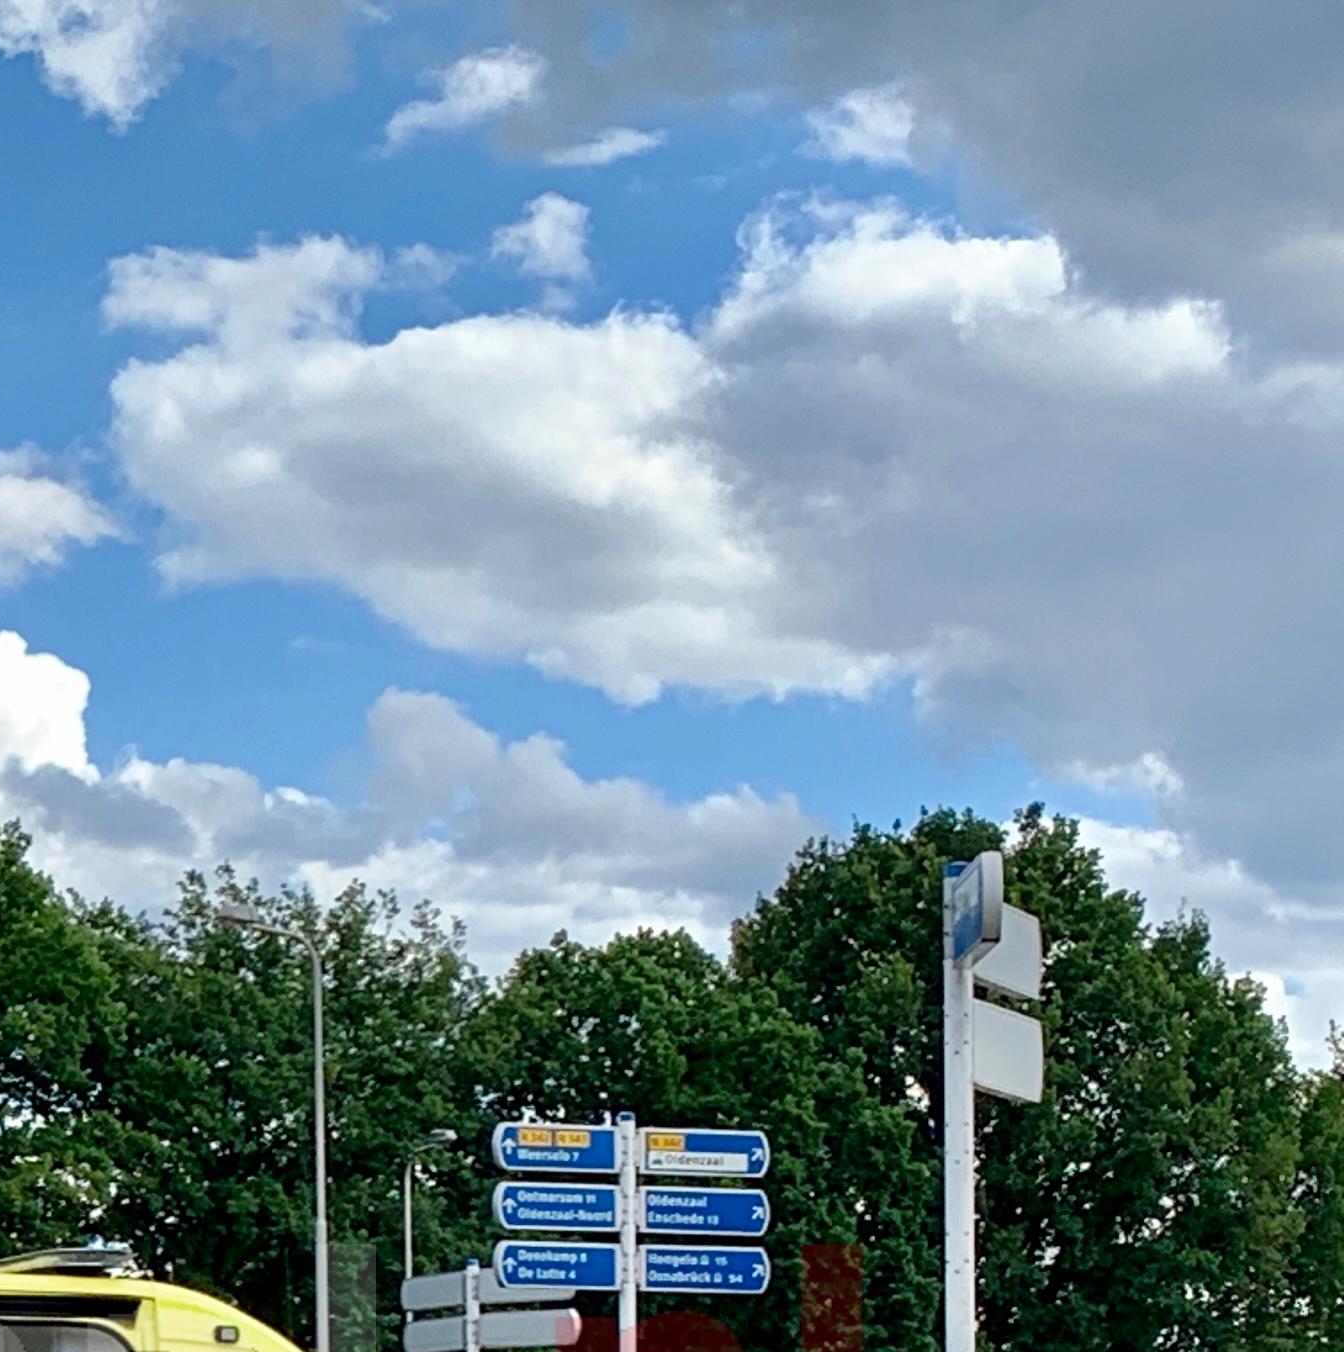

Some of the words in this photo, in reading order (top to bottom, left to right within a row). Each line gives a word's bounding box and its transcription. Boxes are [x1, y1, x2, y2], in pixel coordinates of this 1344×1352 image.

[665, 1153, 725, 1165] Oldenzaal
[647, 1194, 708, 1207] Oldenzaal
[647, 1211, 704, 1224] Enschede
[647, 1252, 698, 1267] Hengelo
[518, 1266, 534, 1279] De
